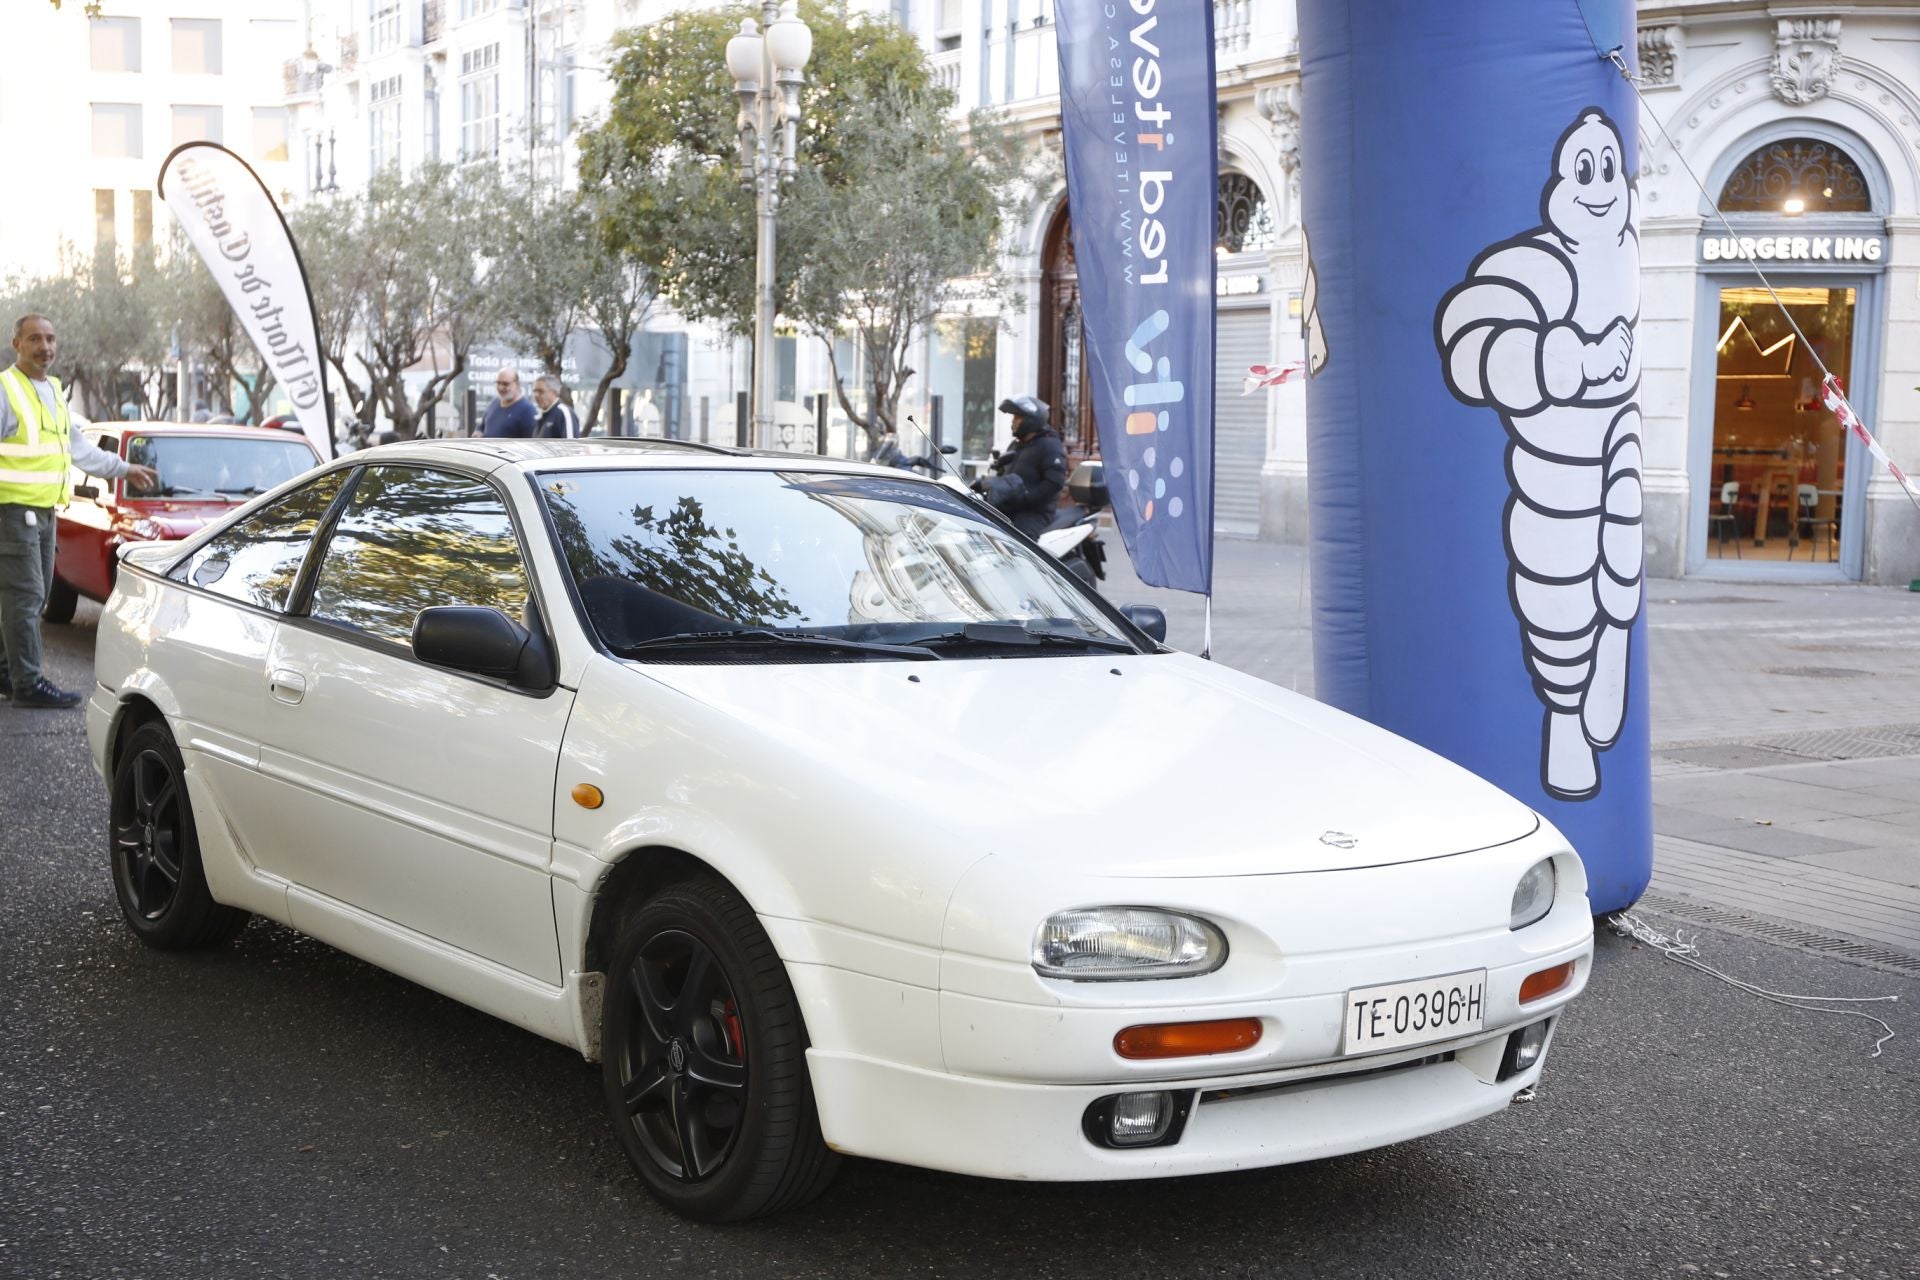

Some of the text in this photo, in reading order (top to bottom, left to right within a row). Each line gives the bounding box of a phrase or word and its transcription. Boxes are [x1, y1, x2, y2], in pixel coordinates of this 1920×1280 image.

[1703, 237, 1882, 261] BURGER KING
[468, 354, 500, 367] Todo
[1354, 983, 1482, 1040] TE-0396-H
